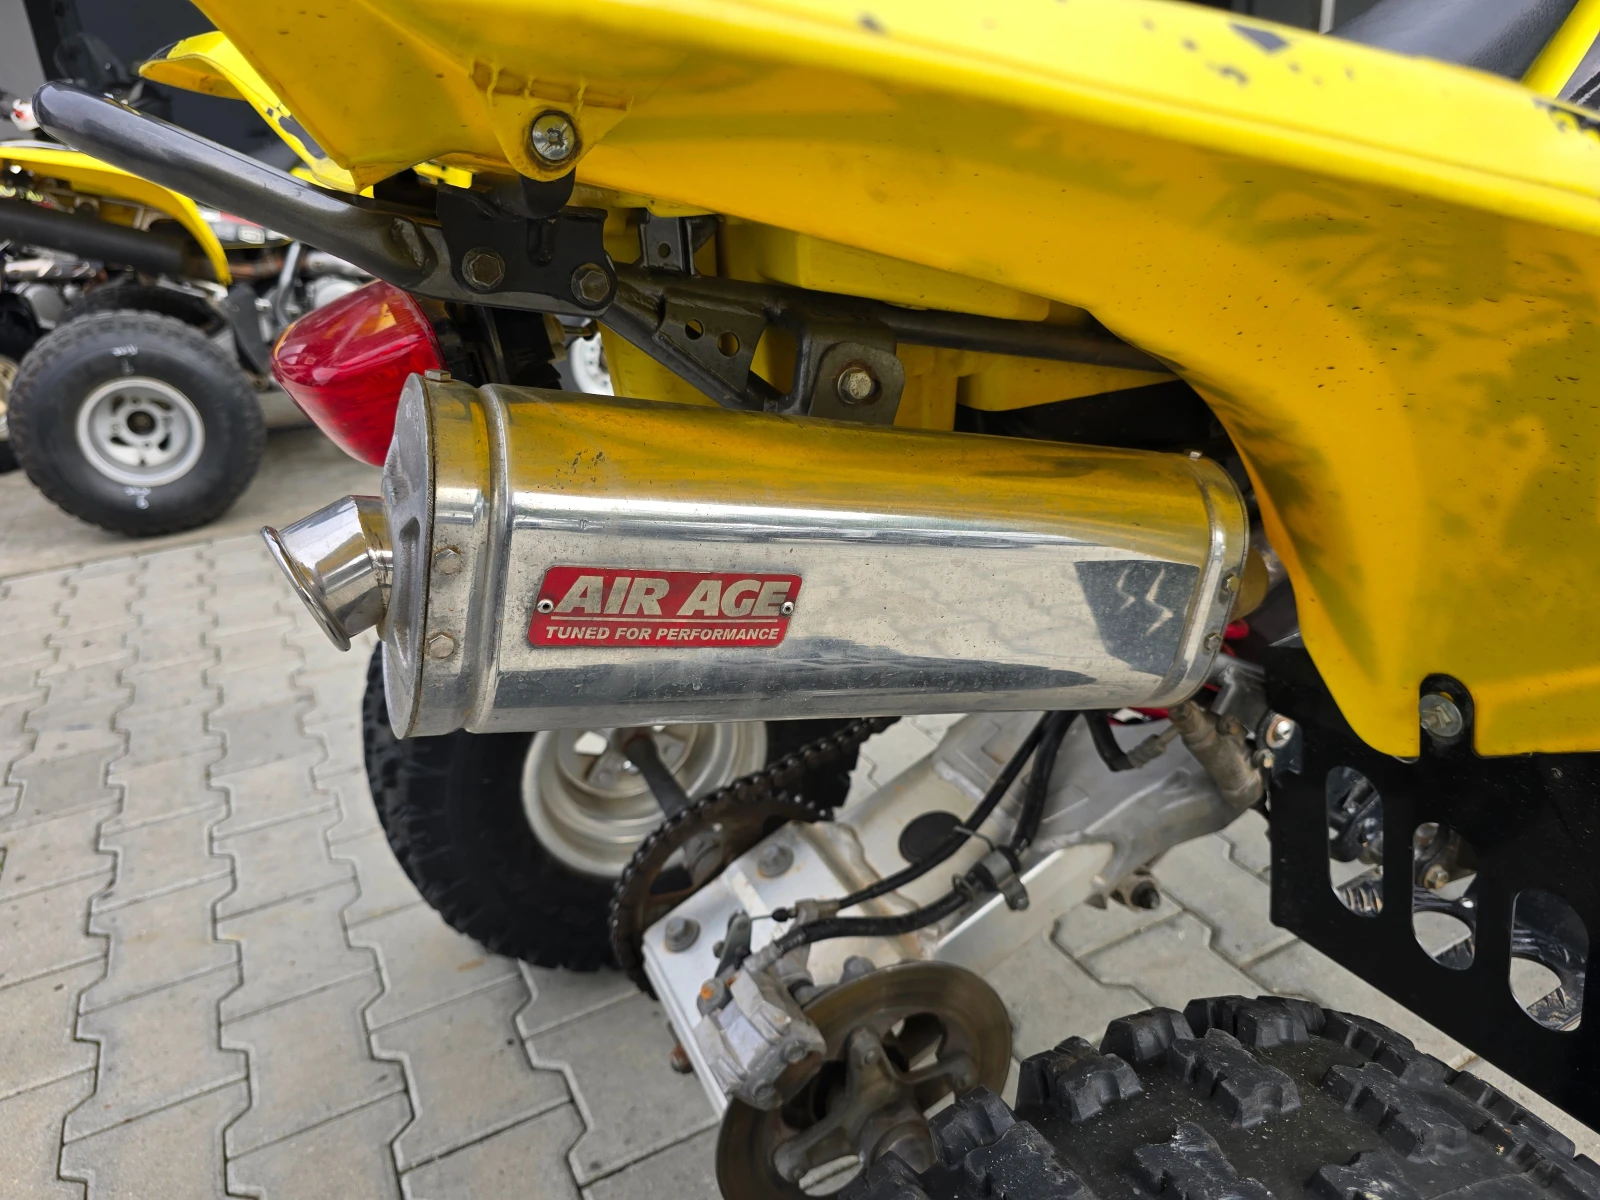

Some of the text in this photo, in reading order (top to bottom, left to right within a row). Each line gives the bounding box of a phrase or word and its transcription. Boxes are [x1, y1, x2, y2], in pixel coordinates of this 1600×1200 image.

[553, 575, 791, 617] AIR AGE
[546, 626, 780, 641] TUNED FOR PERFORMANCE
